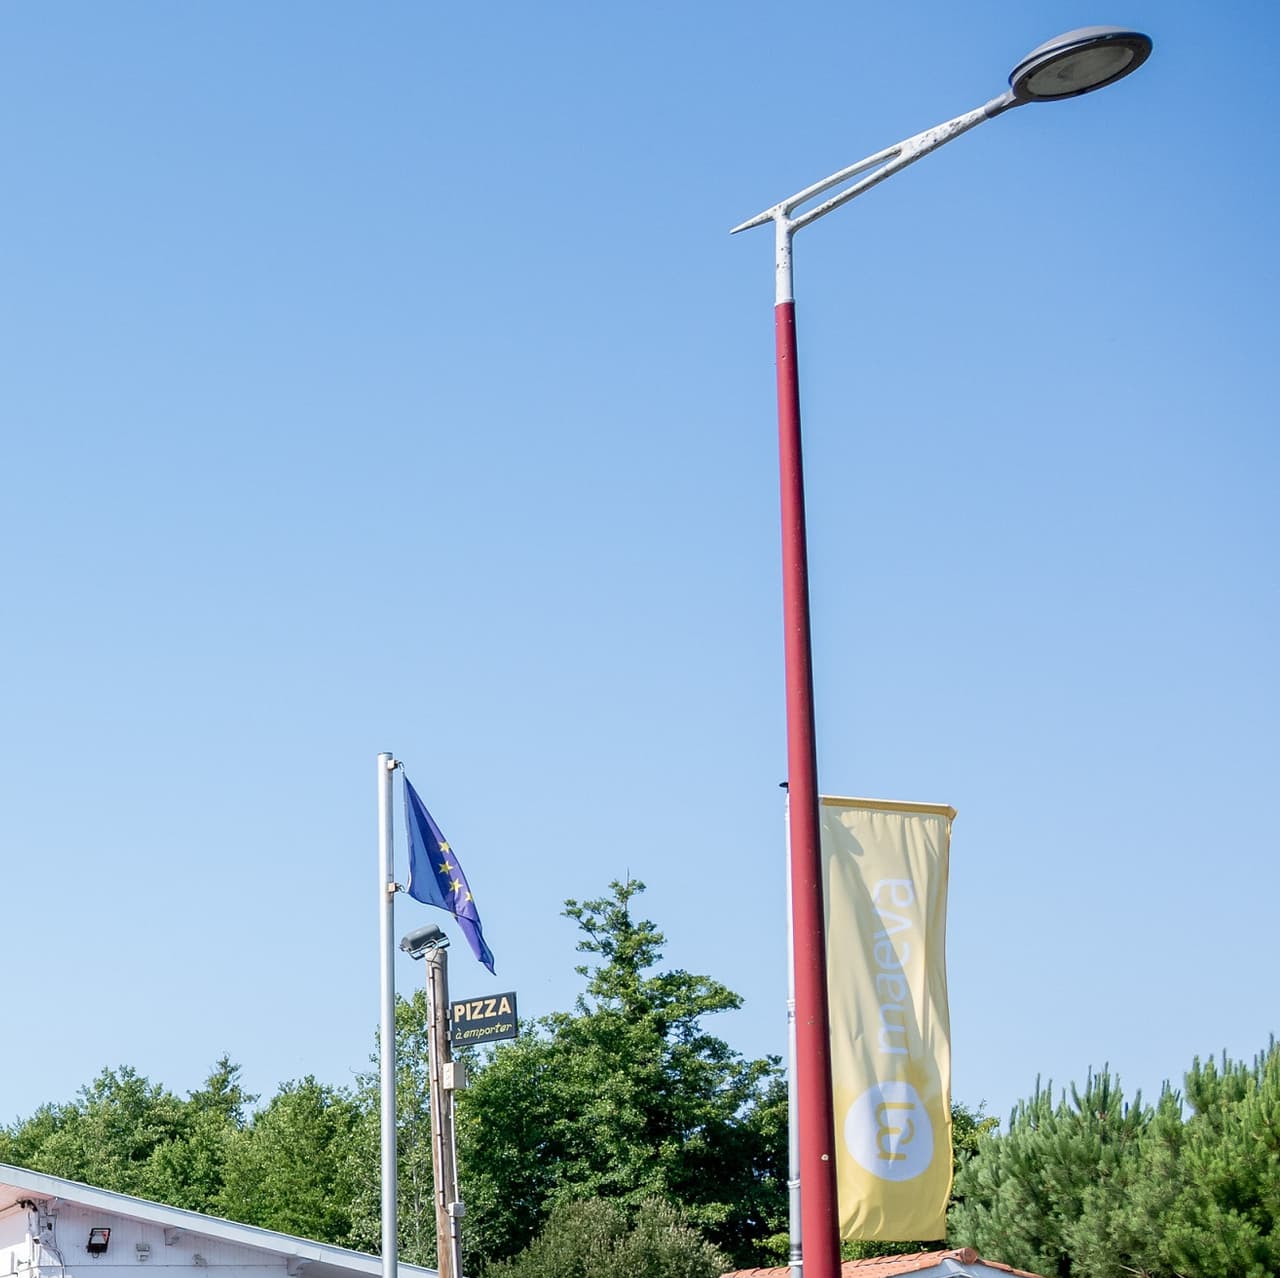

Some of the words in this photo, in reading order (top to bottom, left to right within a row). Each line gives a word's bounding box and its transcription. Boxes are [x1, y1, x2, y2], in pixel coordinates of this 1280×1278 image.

[872, 878, 914, 1055] maeva
[454, 996, 512, 1023] PIZZA
[455, 1027, 463, 1040] à
[463, 1022, 513, 1039] emporter
